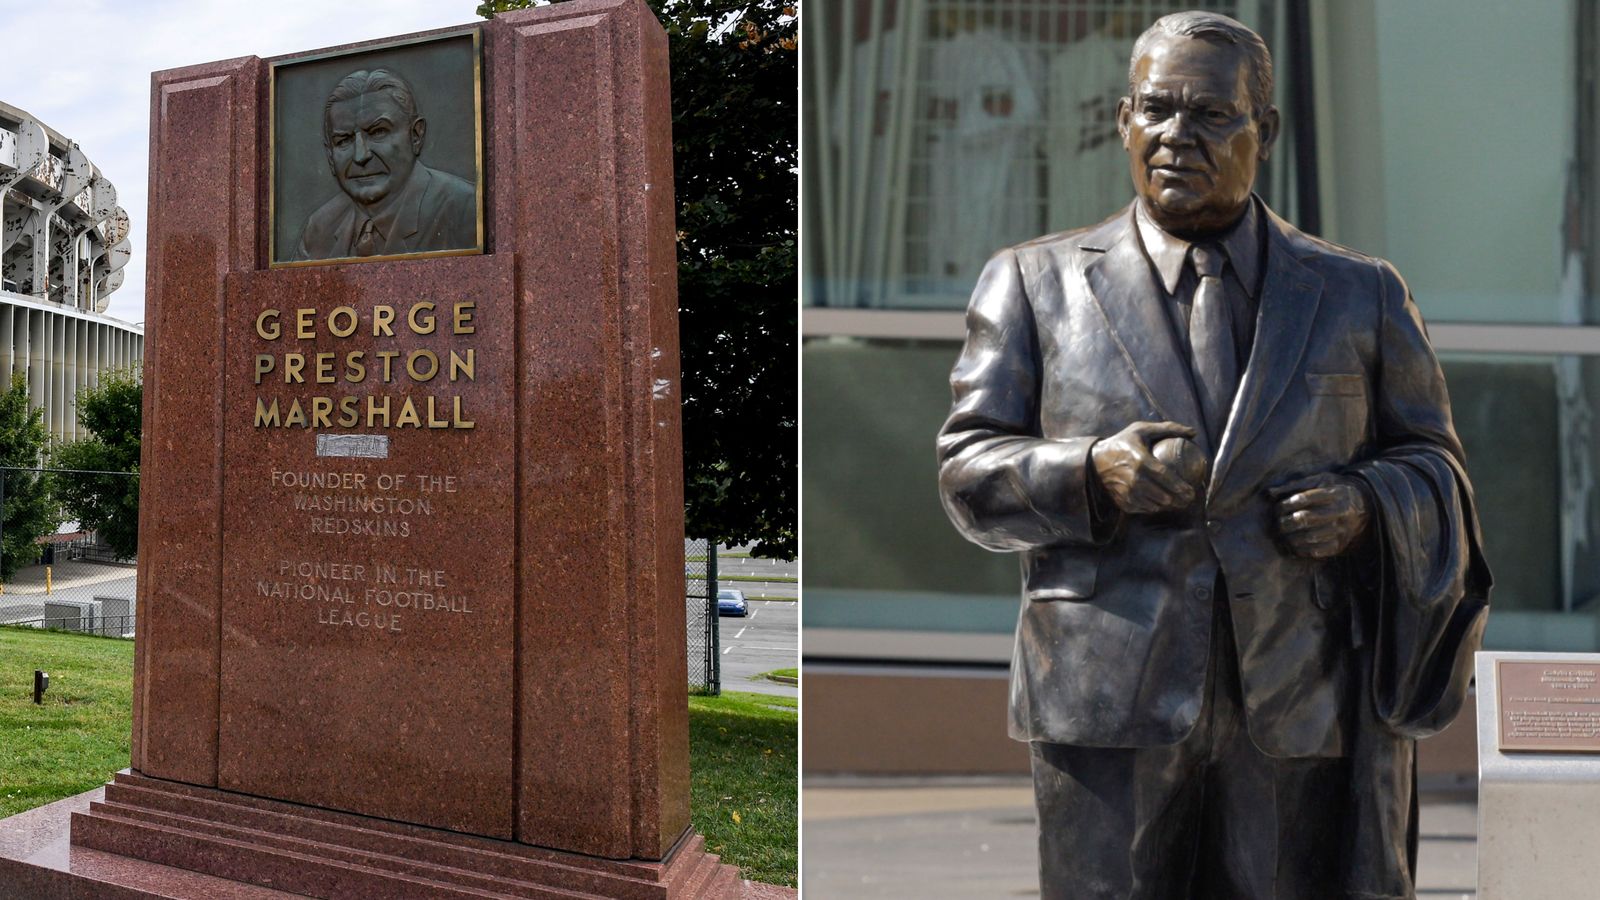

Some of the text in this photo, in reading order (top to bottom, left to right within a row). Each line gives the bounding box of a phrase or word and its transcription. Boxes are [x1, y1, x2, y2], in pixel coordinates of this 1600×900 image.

[256, 301, 475, 340] GEORGE
[255, 348, 475, 384] PRESTON
[254, 396, 475, 429] MARSHALL
[271, 471, 458, 493] FOUNDER OF THE
[294, 495, 431, 516] WASHINGTON
[311, 517, 411, 538] REDSKINS
[280, 560, 446, 587] PIONEER IN THE
[256, 581, 473, 614] NATIONAL FOOTBALL
[318, 608, 402, 632] LEAGUE
